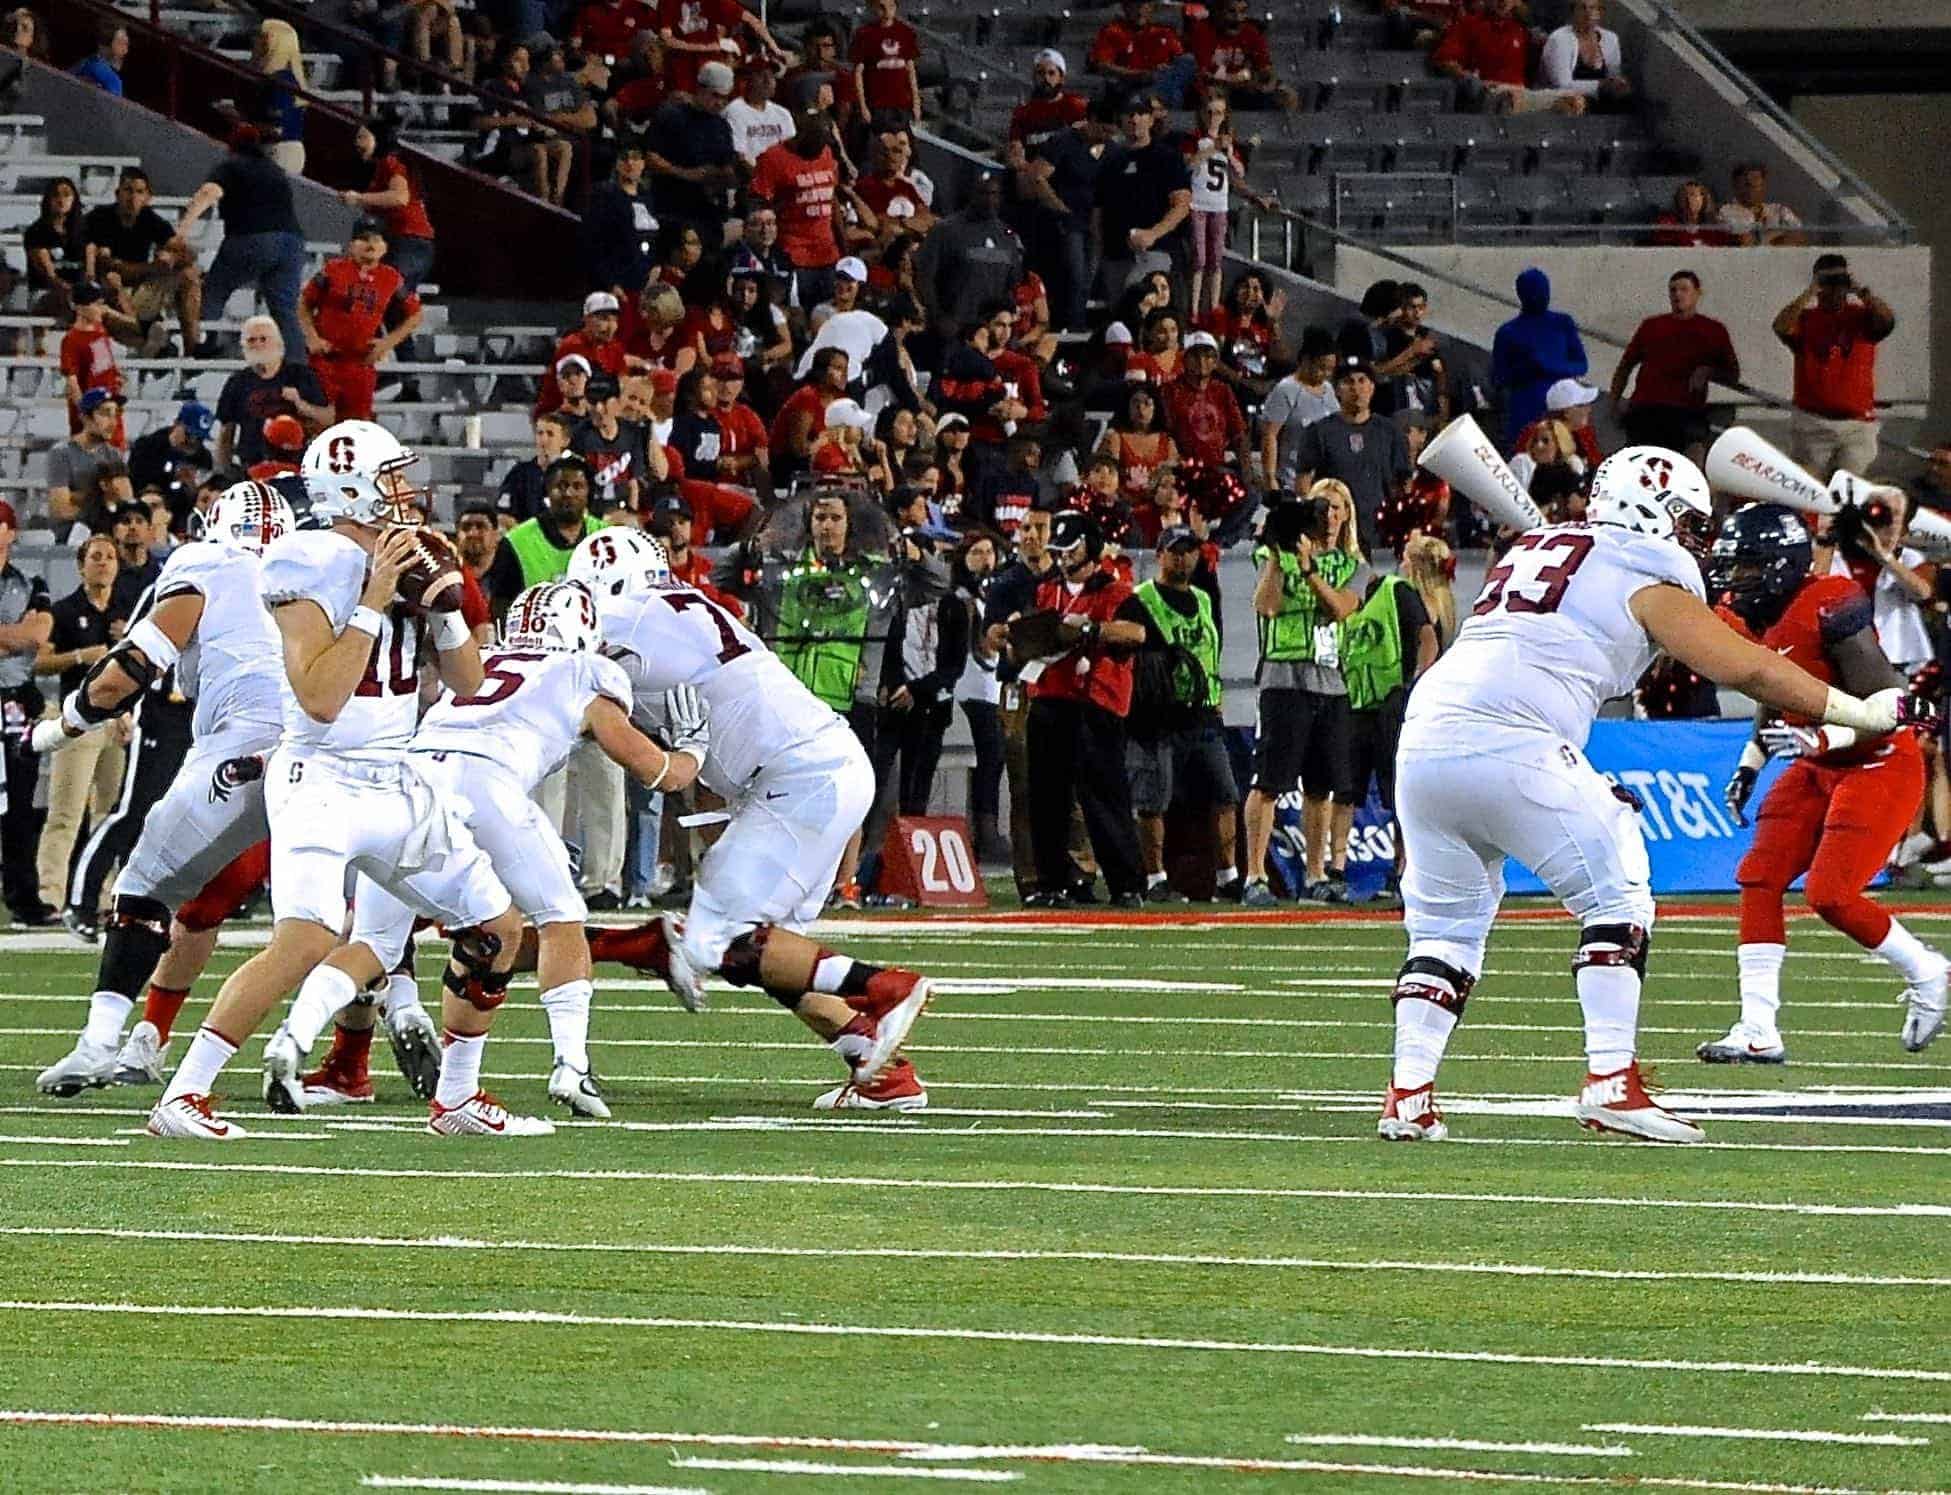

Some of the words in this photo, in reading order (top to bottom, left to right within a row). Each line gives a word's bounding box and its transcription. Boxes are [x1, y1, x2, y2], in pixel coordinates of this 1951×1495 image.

[1206, 158, 1226, 191] 5
[354, 603, 422, 698] 10
[450, 652, 549, 708] 5
[911, 829, 975, 893] 20
